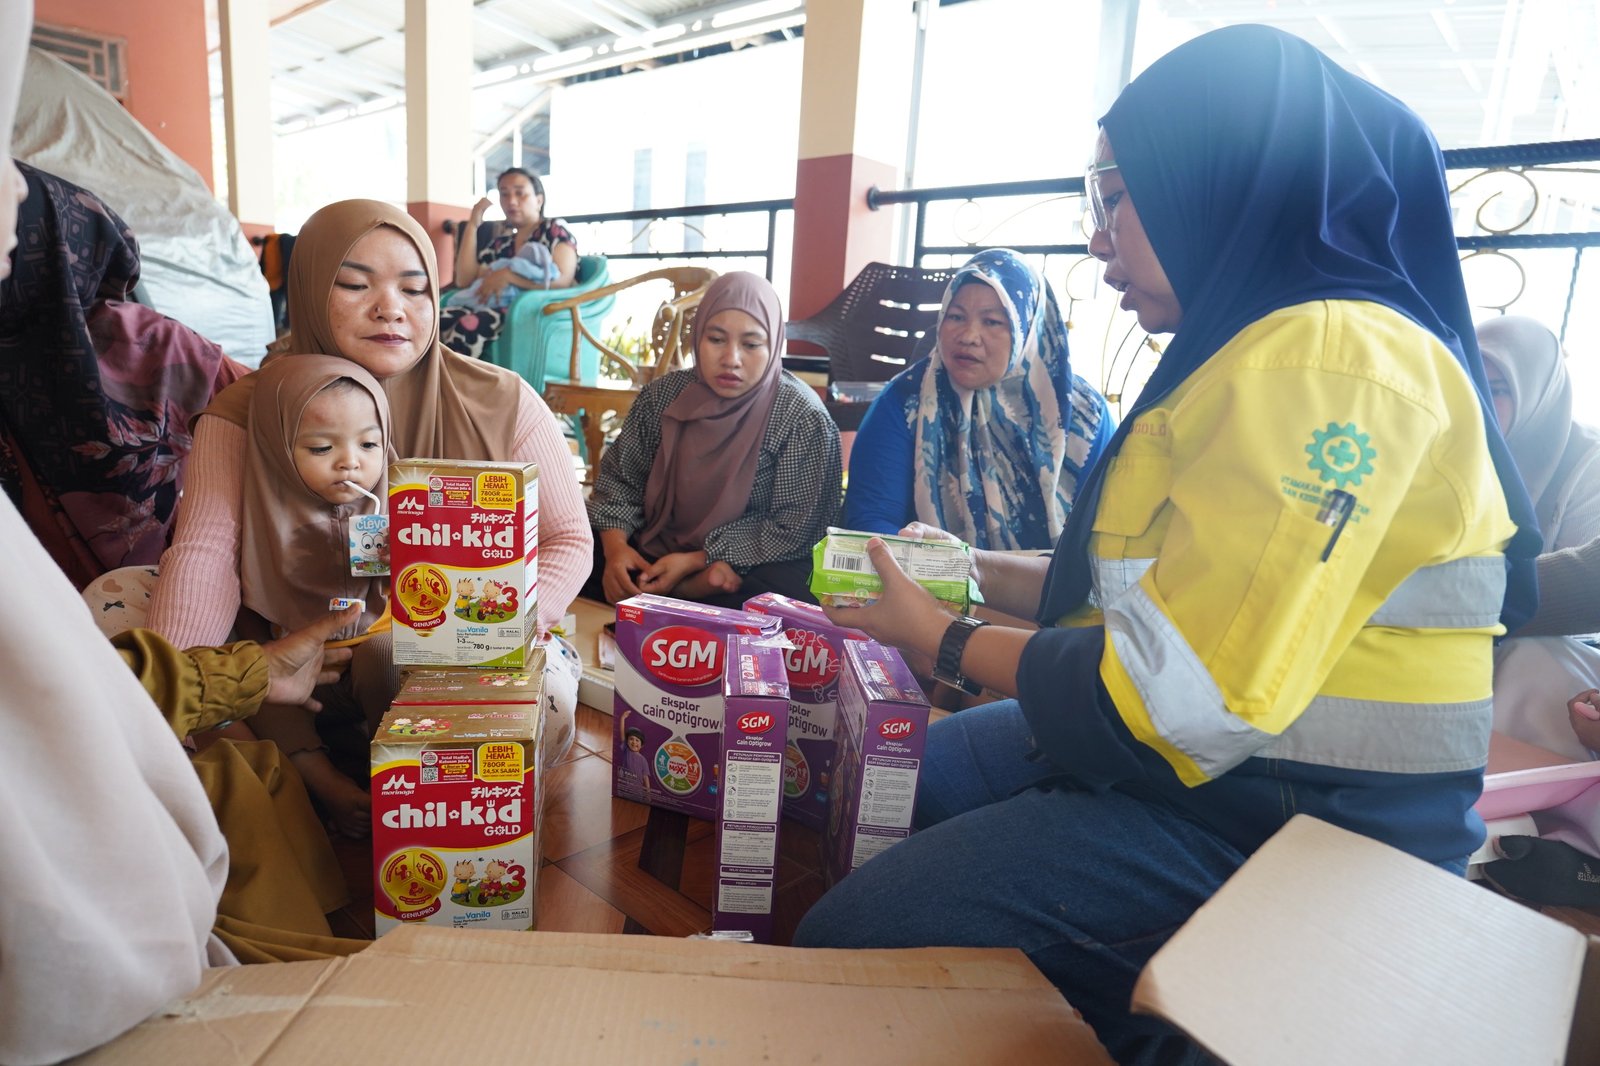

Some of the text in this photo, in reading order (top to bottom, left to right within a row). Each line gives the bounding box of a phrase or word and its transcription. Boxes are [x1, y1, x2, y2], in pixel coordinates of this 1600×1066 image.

[485, 475, 506, 483] LEBIH
[470, 513, 516, 524] チルキッズ
[482, 549, 514, 559] GOLD
[501, 586, 519, 612] 3
[413, 618, 441, 628] GENIUPRO
[651, 639, 718, 669] SGM
[785, 644, 829, 676] GM
[661, 696, 701, 712] Eksplor
[642, 704, 721, 730] Gain Optigrow
[741, 715, 770, 729] SGM
[788, 716, 828, 737] ptigrow
[882, 722, 911, 735] SGM
[748, 740, 772, 748] Optigrow
[888, 745, 912, 753] Optigrow
[485, 752, 515, 760] HEMAT
[471, 785, 523, 799] チルキッズ
[483, 824, 521, 836] GOLD
[505, 864, 527, 892] 3
[401, 906, 435, 919] GENIUPRO
[465, 911, 491, 919] Vanila
